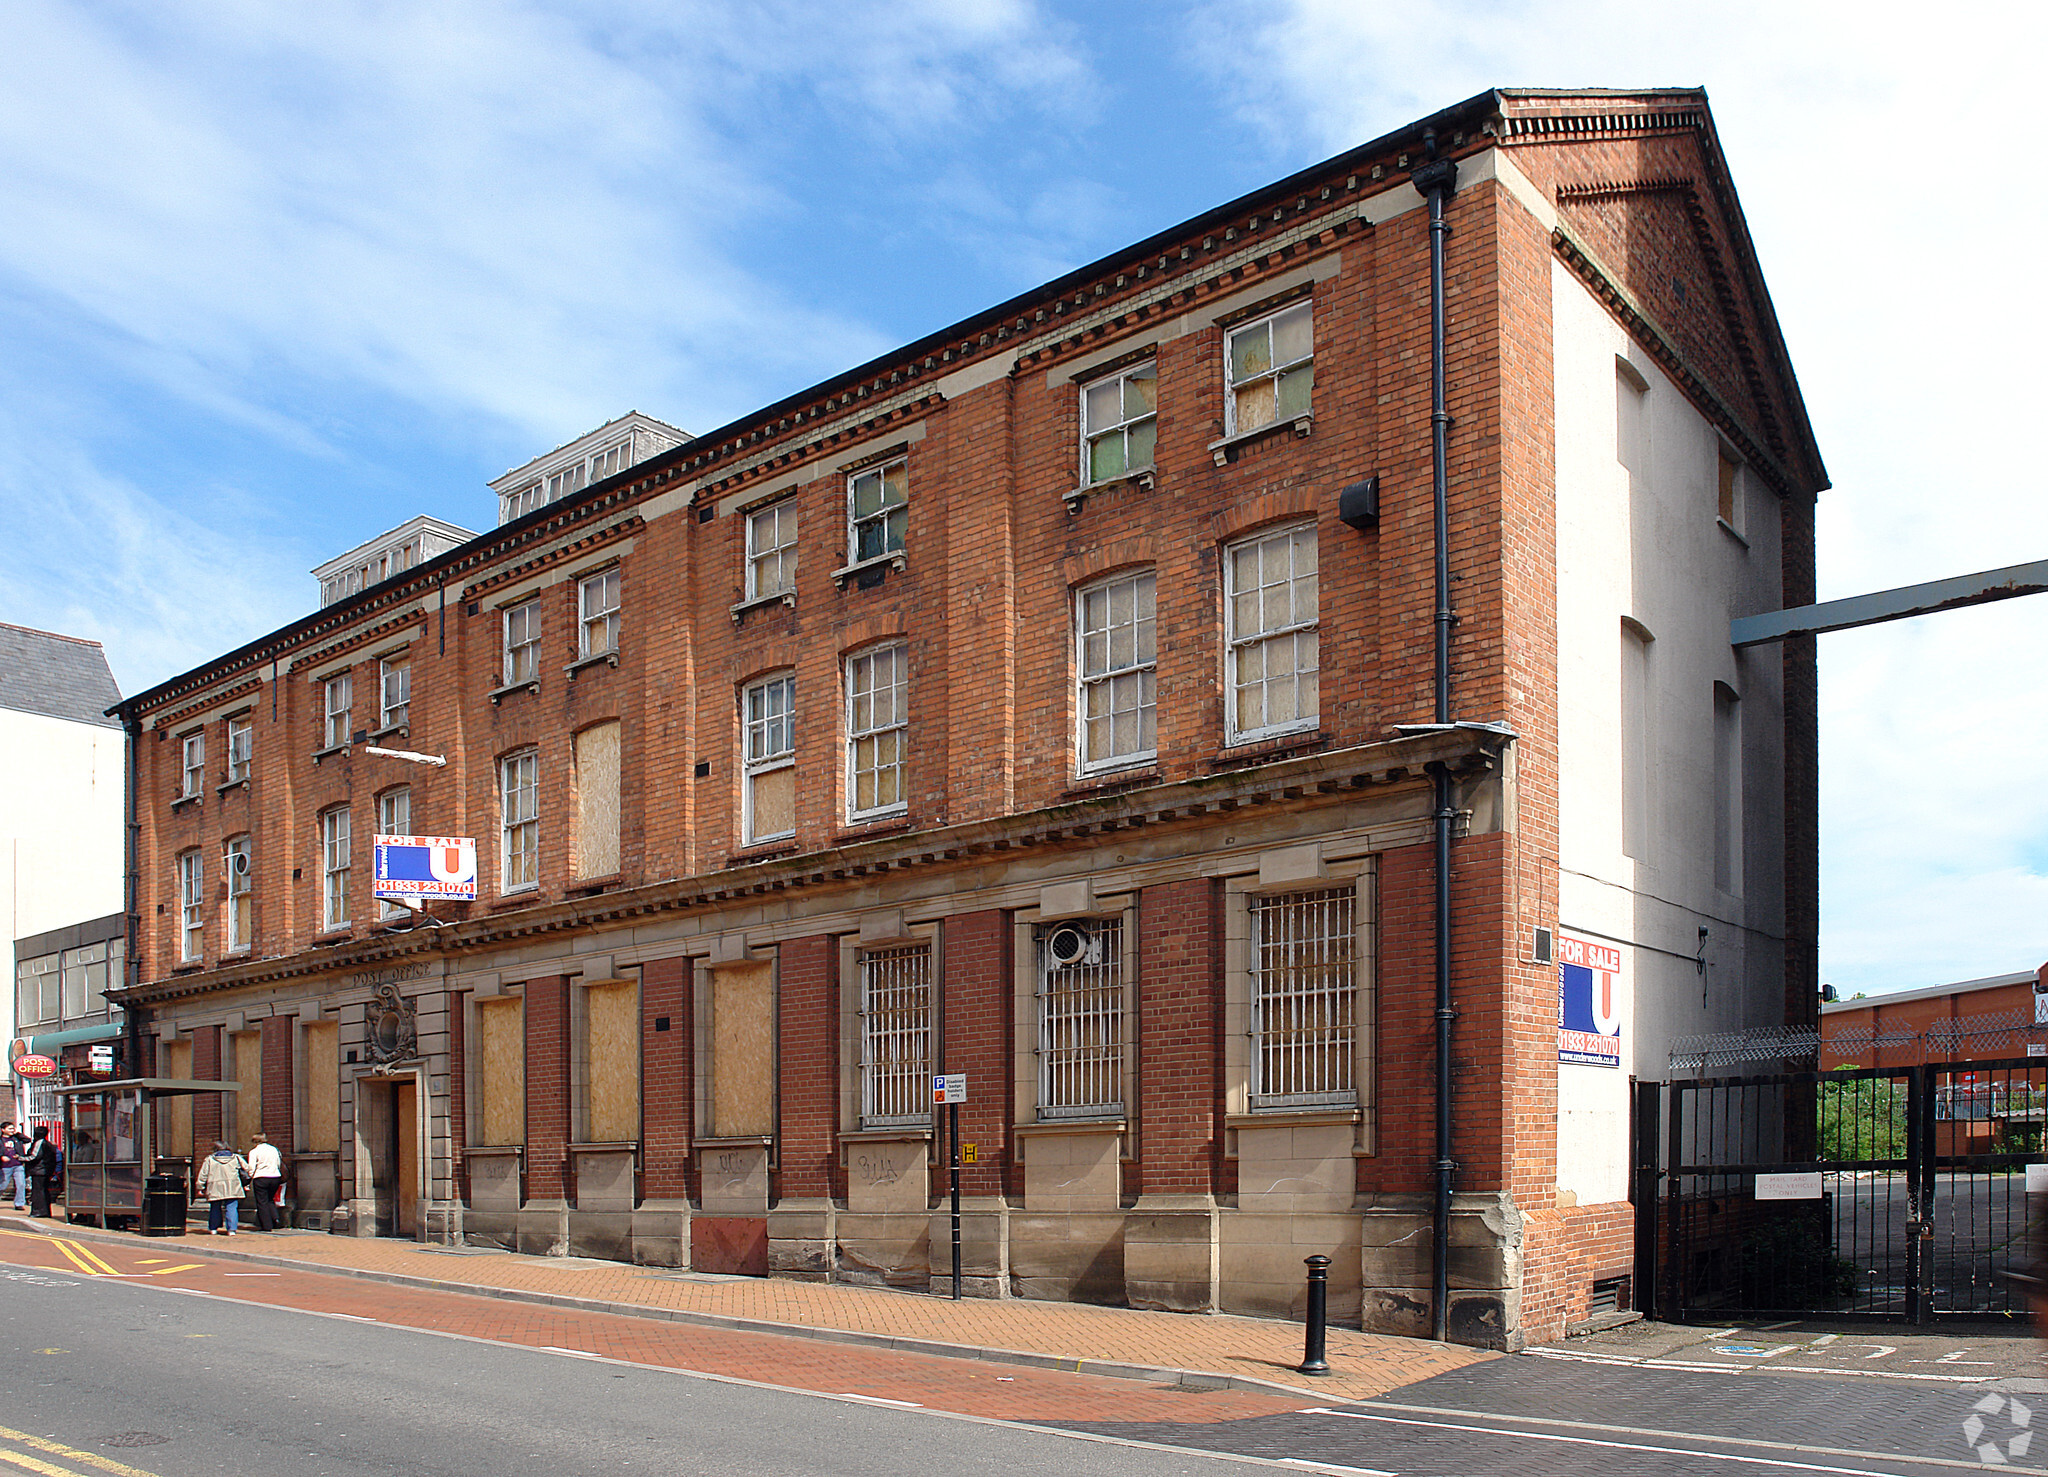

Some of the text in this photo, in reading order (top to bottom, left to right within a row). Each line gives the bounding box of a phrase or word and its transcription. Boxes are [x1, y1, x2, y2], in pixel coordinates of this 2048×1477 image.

[377, 836, 473, 848] FOR SALE
[378, 880, 471, 893] 01933 231070
[1559, 939, 1619, 971] FOR SALE
[353, 962, 431, 987] POST OFFICE
[1558, 1030, 1619, 1055] 01933 231070
[23, 1058, 49, 1066] POST
[18, 1065, 53, 1073] OFFICE
[936, 1078, 944, 1088] P
